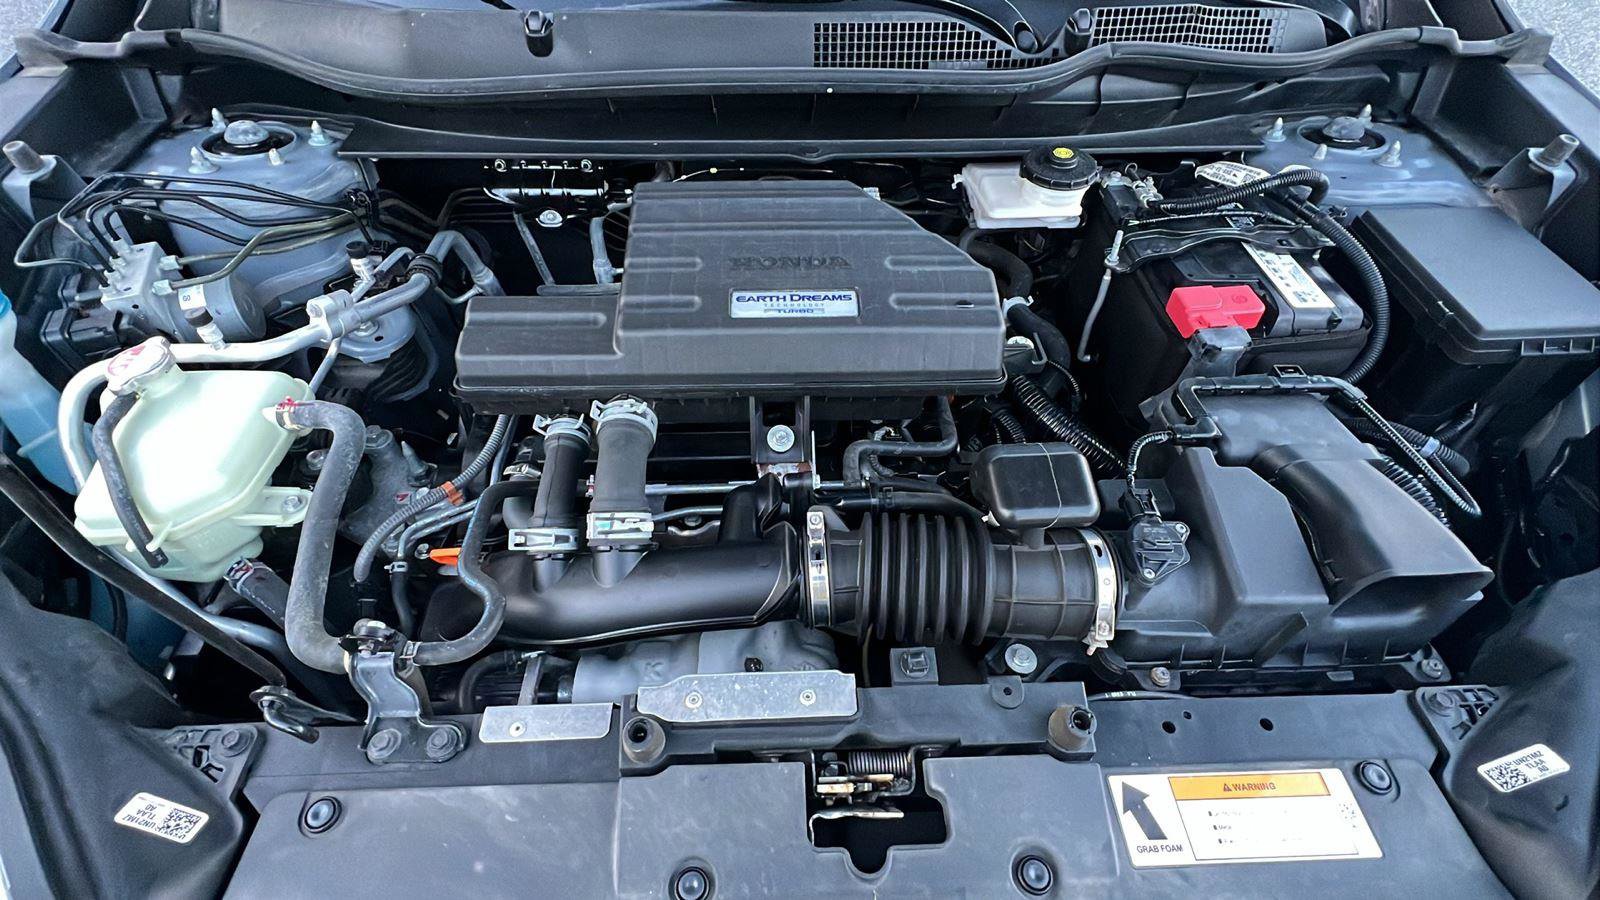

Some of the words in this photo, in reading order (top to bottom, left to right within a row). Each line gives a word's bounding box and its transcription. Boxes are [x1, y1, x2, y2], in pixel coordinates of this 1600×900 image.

[729, 255, 851, 271] HONDA
[736, 294, 786, 303] EARTH
[790, 293, 853, 302] DREAMS
[1232, 781, 1276, 792] WARNING
[1136, 844, 1159, 854] GRAB
[1160, 843, 1184, 853] FOAM
